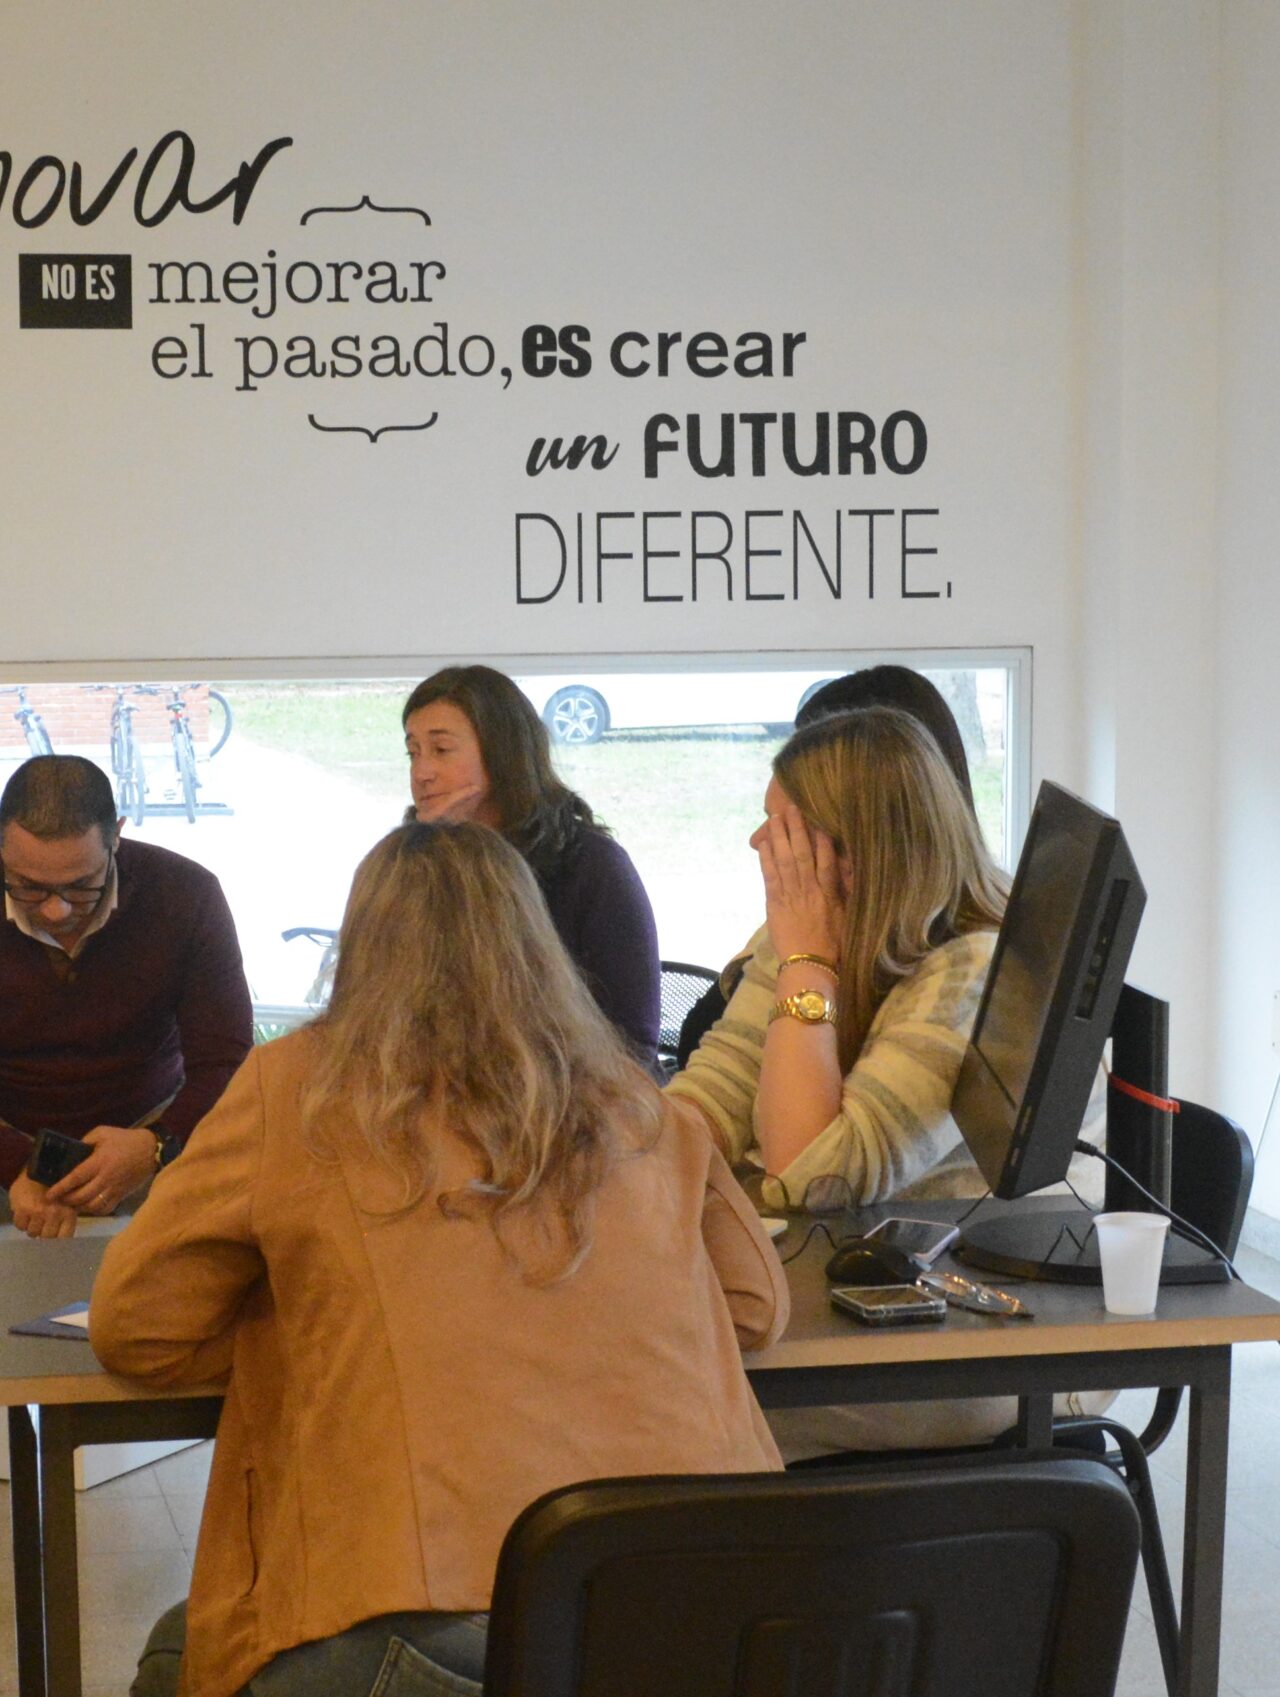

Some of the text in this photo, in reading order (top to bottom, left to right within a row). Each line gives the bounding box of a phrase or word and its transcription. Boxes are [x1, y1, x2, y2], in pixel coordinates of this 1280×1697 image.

[41, 249, 447, 319] NO ES mejorar
[151, 322, 807, 391] el pasado, es crear
[525, 409, 928, 479] un FUTURO
